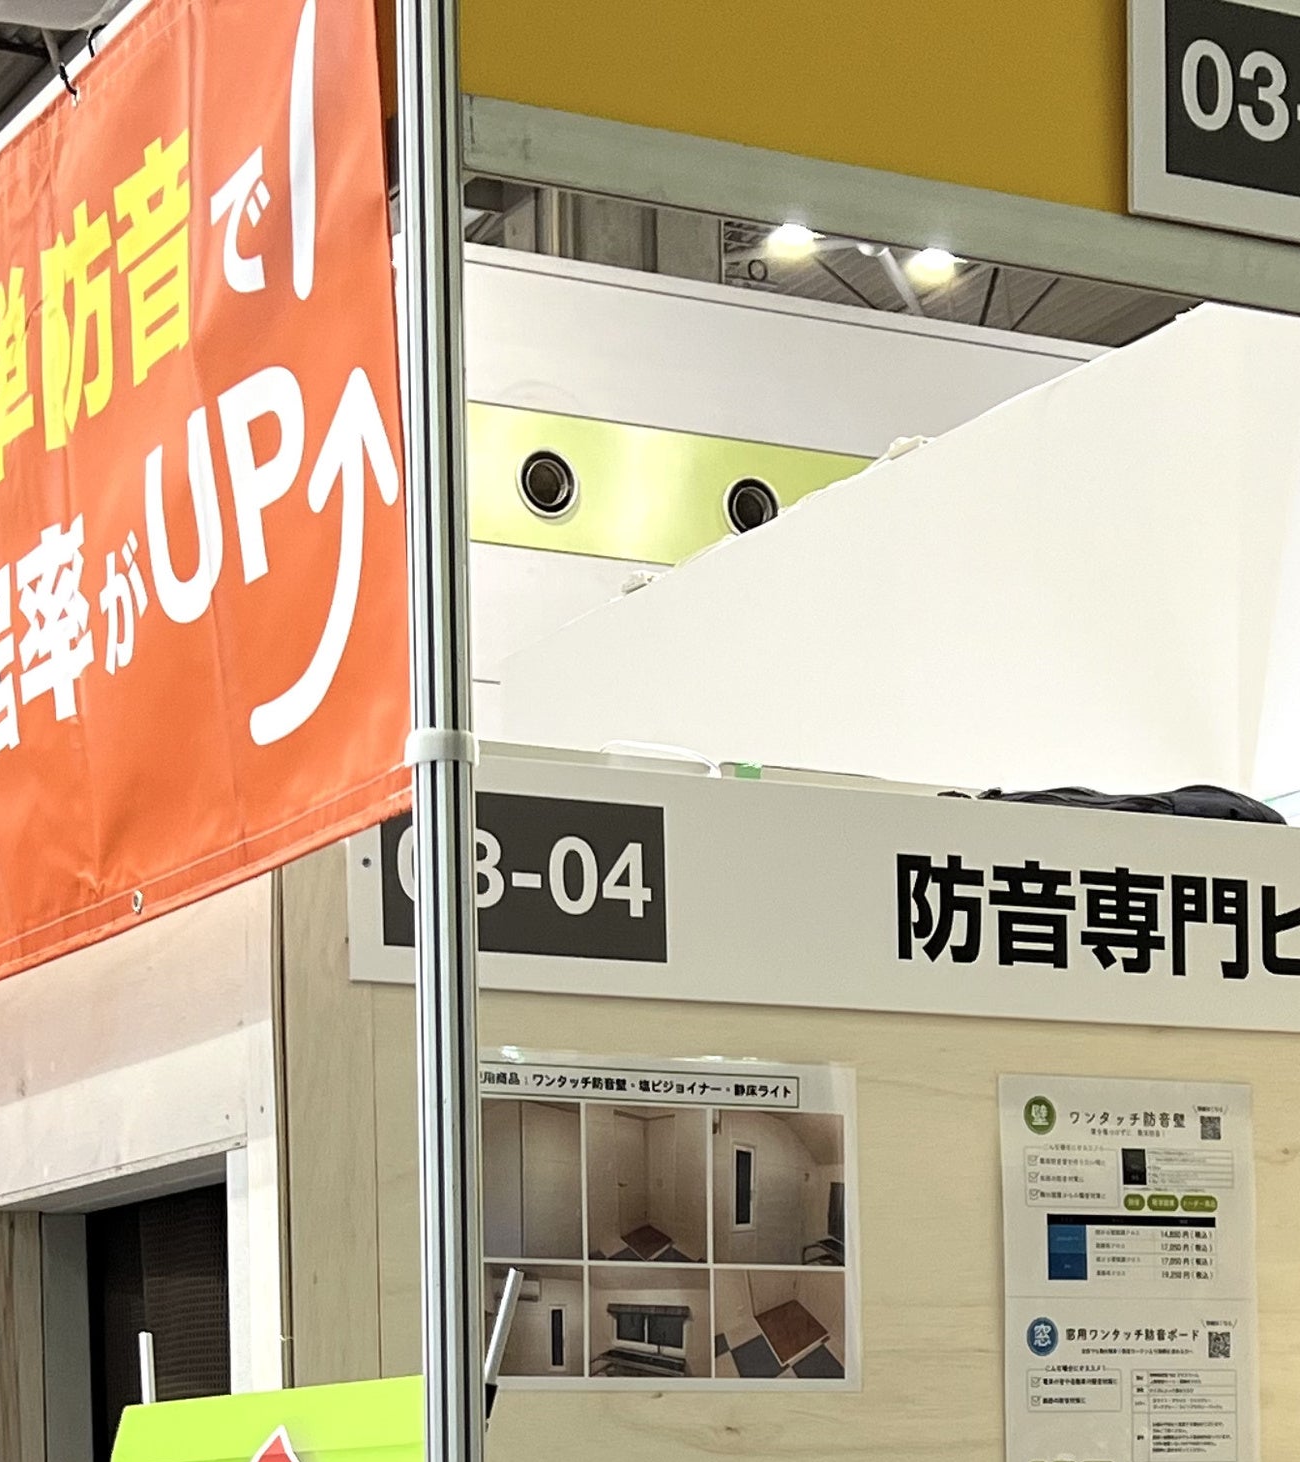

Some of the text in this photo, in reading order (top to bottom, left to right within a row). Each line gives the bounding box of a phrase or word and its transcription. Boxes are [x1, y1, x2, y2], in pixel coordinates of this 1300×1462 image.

[1069, 1110, 1186, 1129] ワンタッチ防音壁
